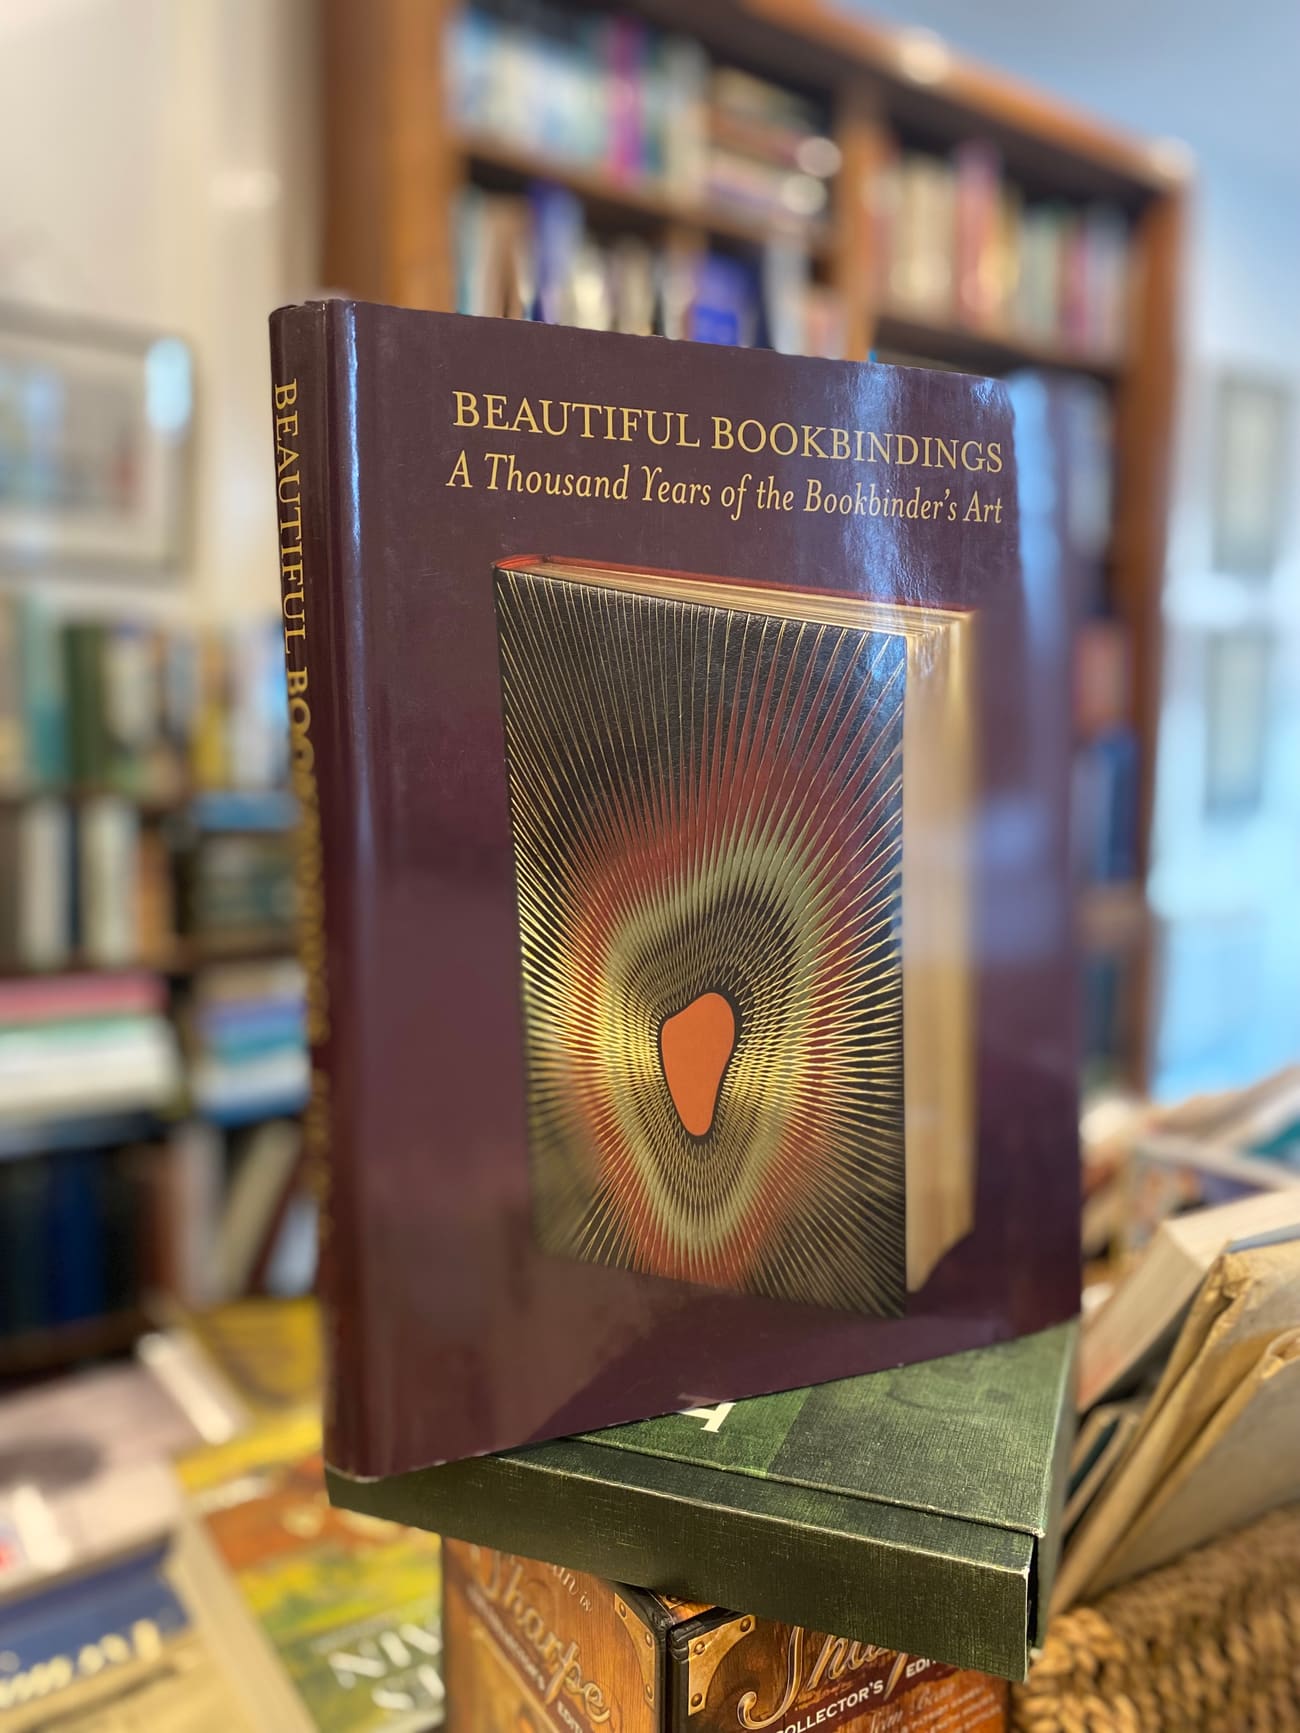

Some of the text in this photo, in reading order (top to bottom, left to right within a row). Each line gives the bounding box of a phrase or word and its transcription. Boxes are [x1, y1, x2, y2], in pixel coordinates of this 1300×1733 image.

[452, 391, 1003, 473] BEAUTIFUL BOOKBINDINGS
[274, 378, 306, 655] BEAUTIFUL
[446, 450, 1003, 524] A Thousand Years of the Bookbinder's Art
[905, 1658, 937, 1679] EDI
